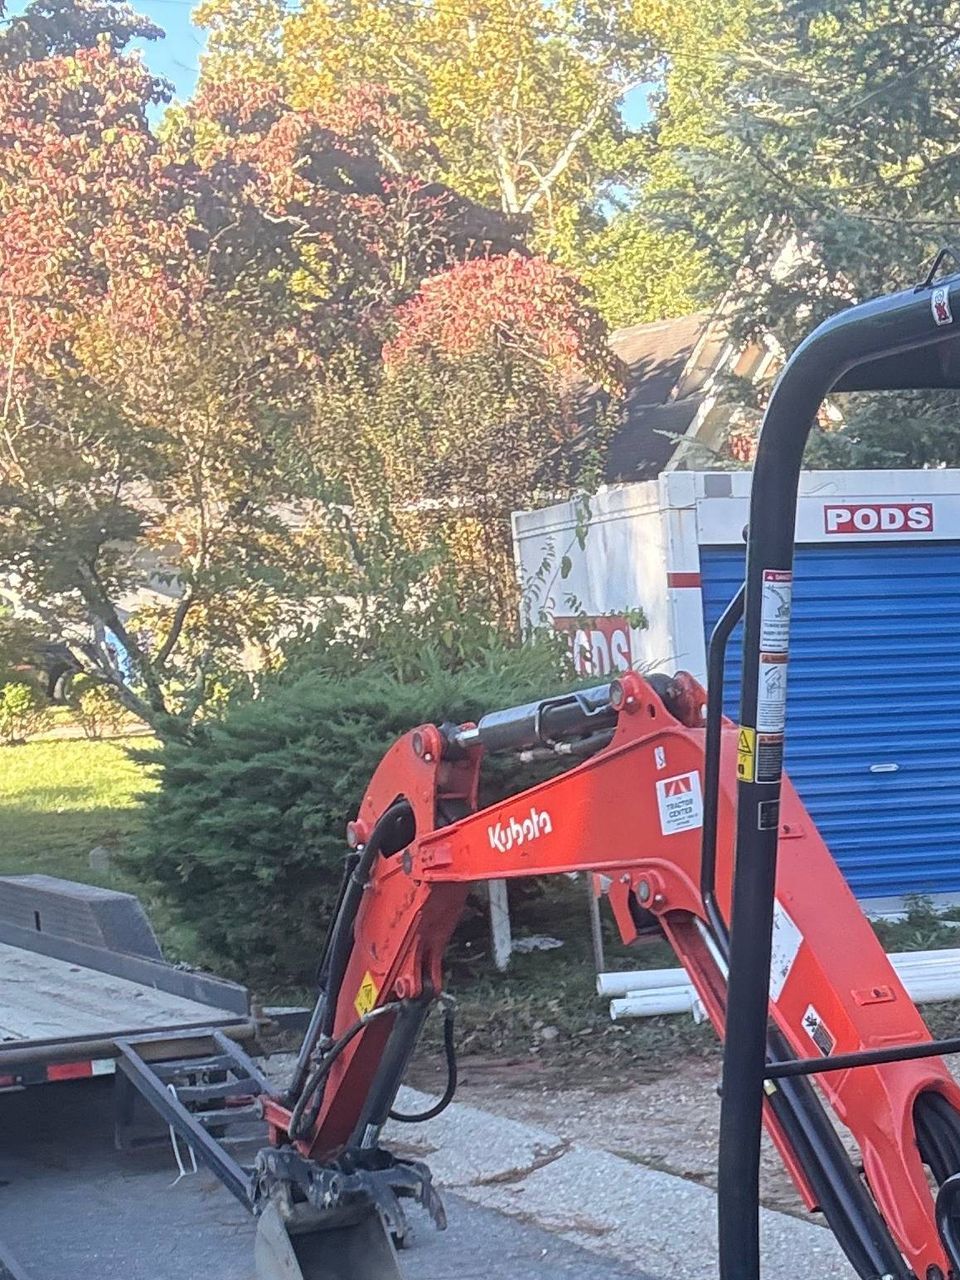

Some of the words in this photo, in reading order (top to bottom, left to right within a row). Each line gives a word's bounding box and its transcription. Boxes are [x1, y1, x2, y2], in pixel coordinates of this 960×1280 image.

[826, 506, 931, 531] PODS
[572, 628, 629, 677] ODS
[666, 798, 693, 810] TRACTOR
[669, 806, 693, 818] CENTER
[487, 807, 553, 853] Kubota
